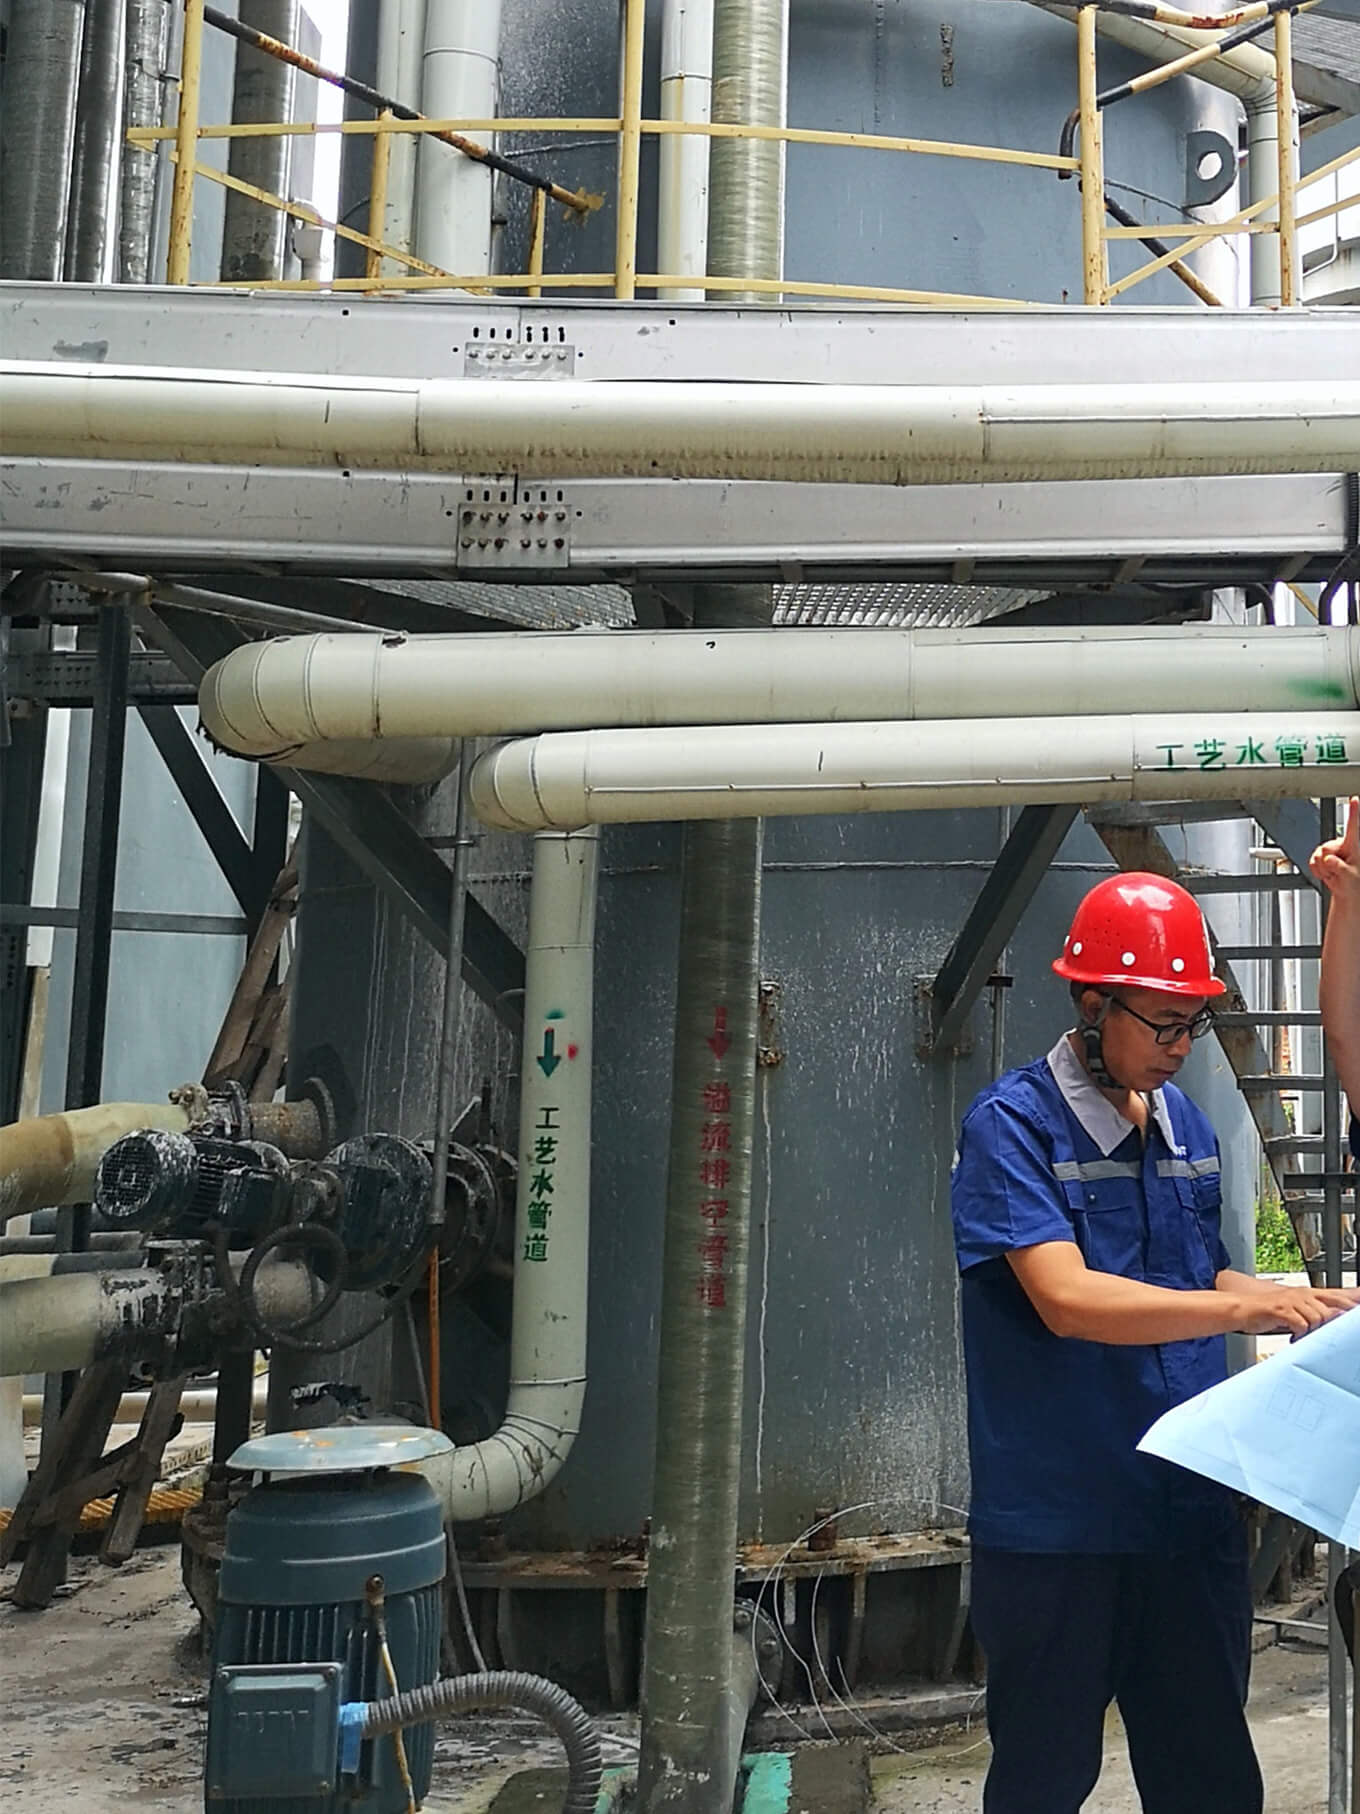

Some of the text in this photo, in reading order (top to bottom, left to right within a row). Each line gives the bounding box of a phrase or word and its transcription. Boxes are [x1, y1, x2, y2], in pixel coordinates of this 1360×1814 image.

[1152, 735, 1349, 772] 工艺水管道
[523, 1106, 560, 1262] 工艺水管道
